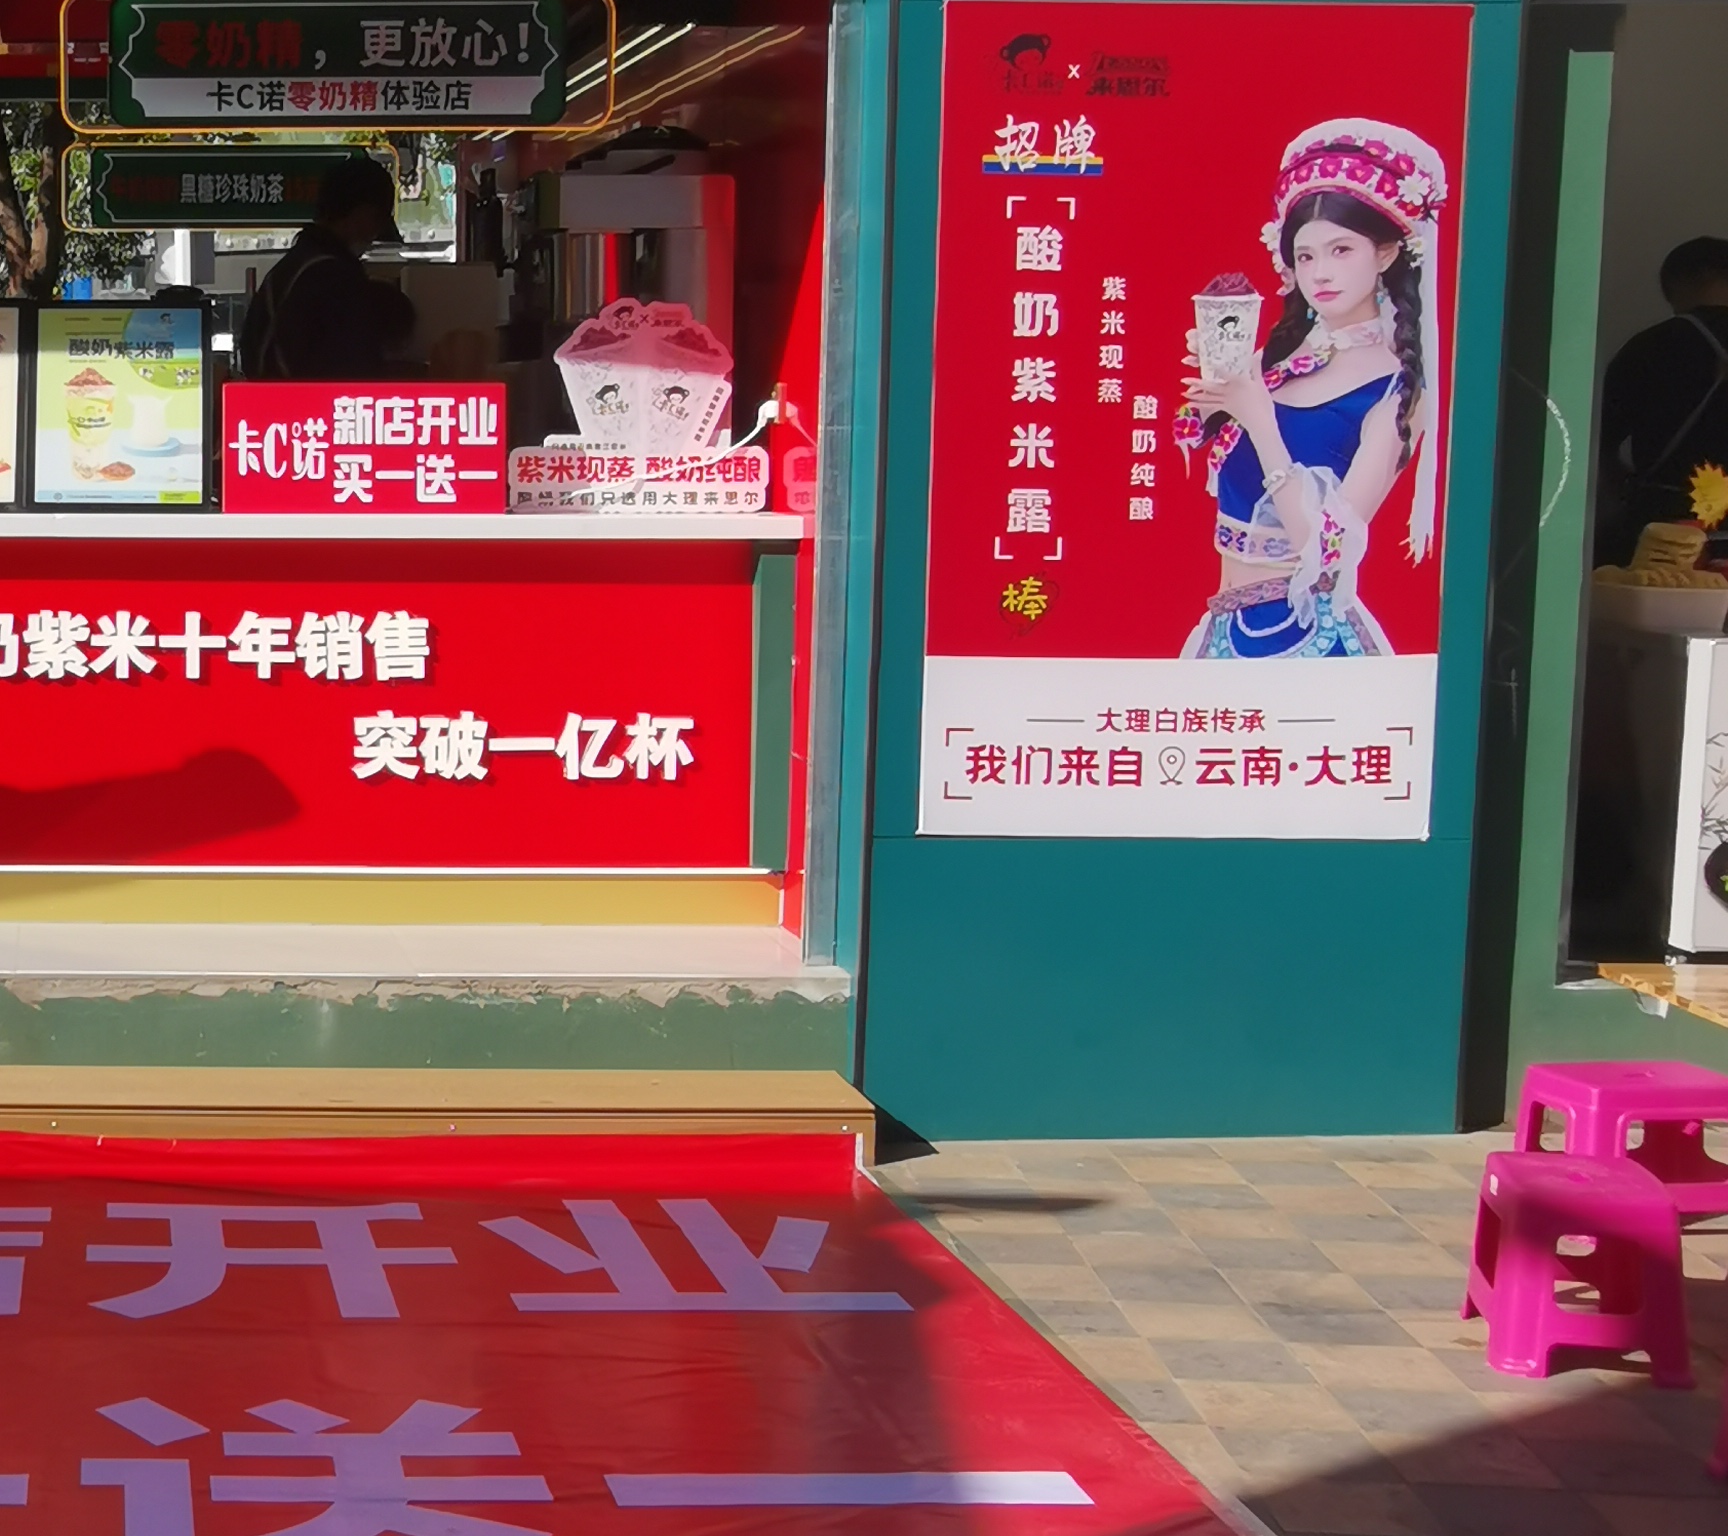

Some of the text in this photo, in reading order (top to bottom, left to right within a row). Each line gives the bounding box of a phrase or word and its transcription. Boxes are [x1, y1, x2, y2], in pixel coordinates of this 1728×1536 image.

[206, 80, 473, 113] 卡C诺零奶精体验店
[994, 114, 1096, 174] 招牌
[180, 173, 285, 204] 黑糖珍珠奶茶
[69, 338, 175, 361] 酸奶紫米露
[1097, 276, 1127, 404] 紫米现蒸
[1007, 225, 1064, 534] 酸奶紫米露
[333, 396, 499, 445] 新店开业
[228, 417, 330, 481] 卡C诺
[516, 455, 635, 483] 紫米现蒸
[646, 455, 761, 483] 酸奶纯酿
[1128, 394, 1159, 521] 酸奶纯酿
[333, 454, 499, 504] 买一送一
[1002, 576, 1049, 621] 棒
[1096, 707, 1266, 734] 大理白族传承
[351, 710, 695, 781] 突破一亿杯
[965, 744, 1144, 787] 我们来自
